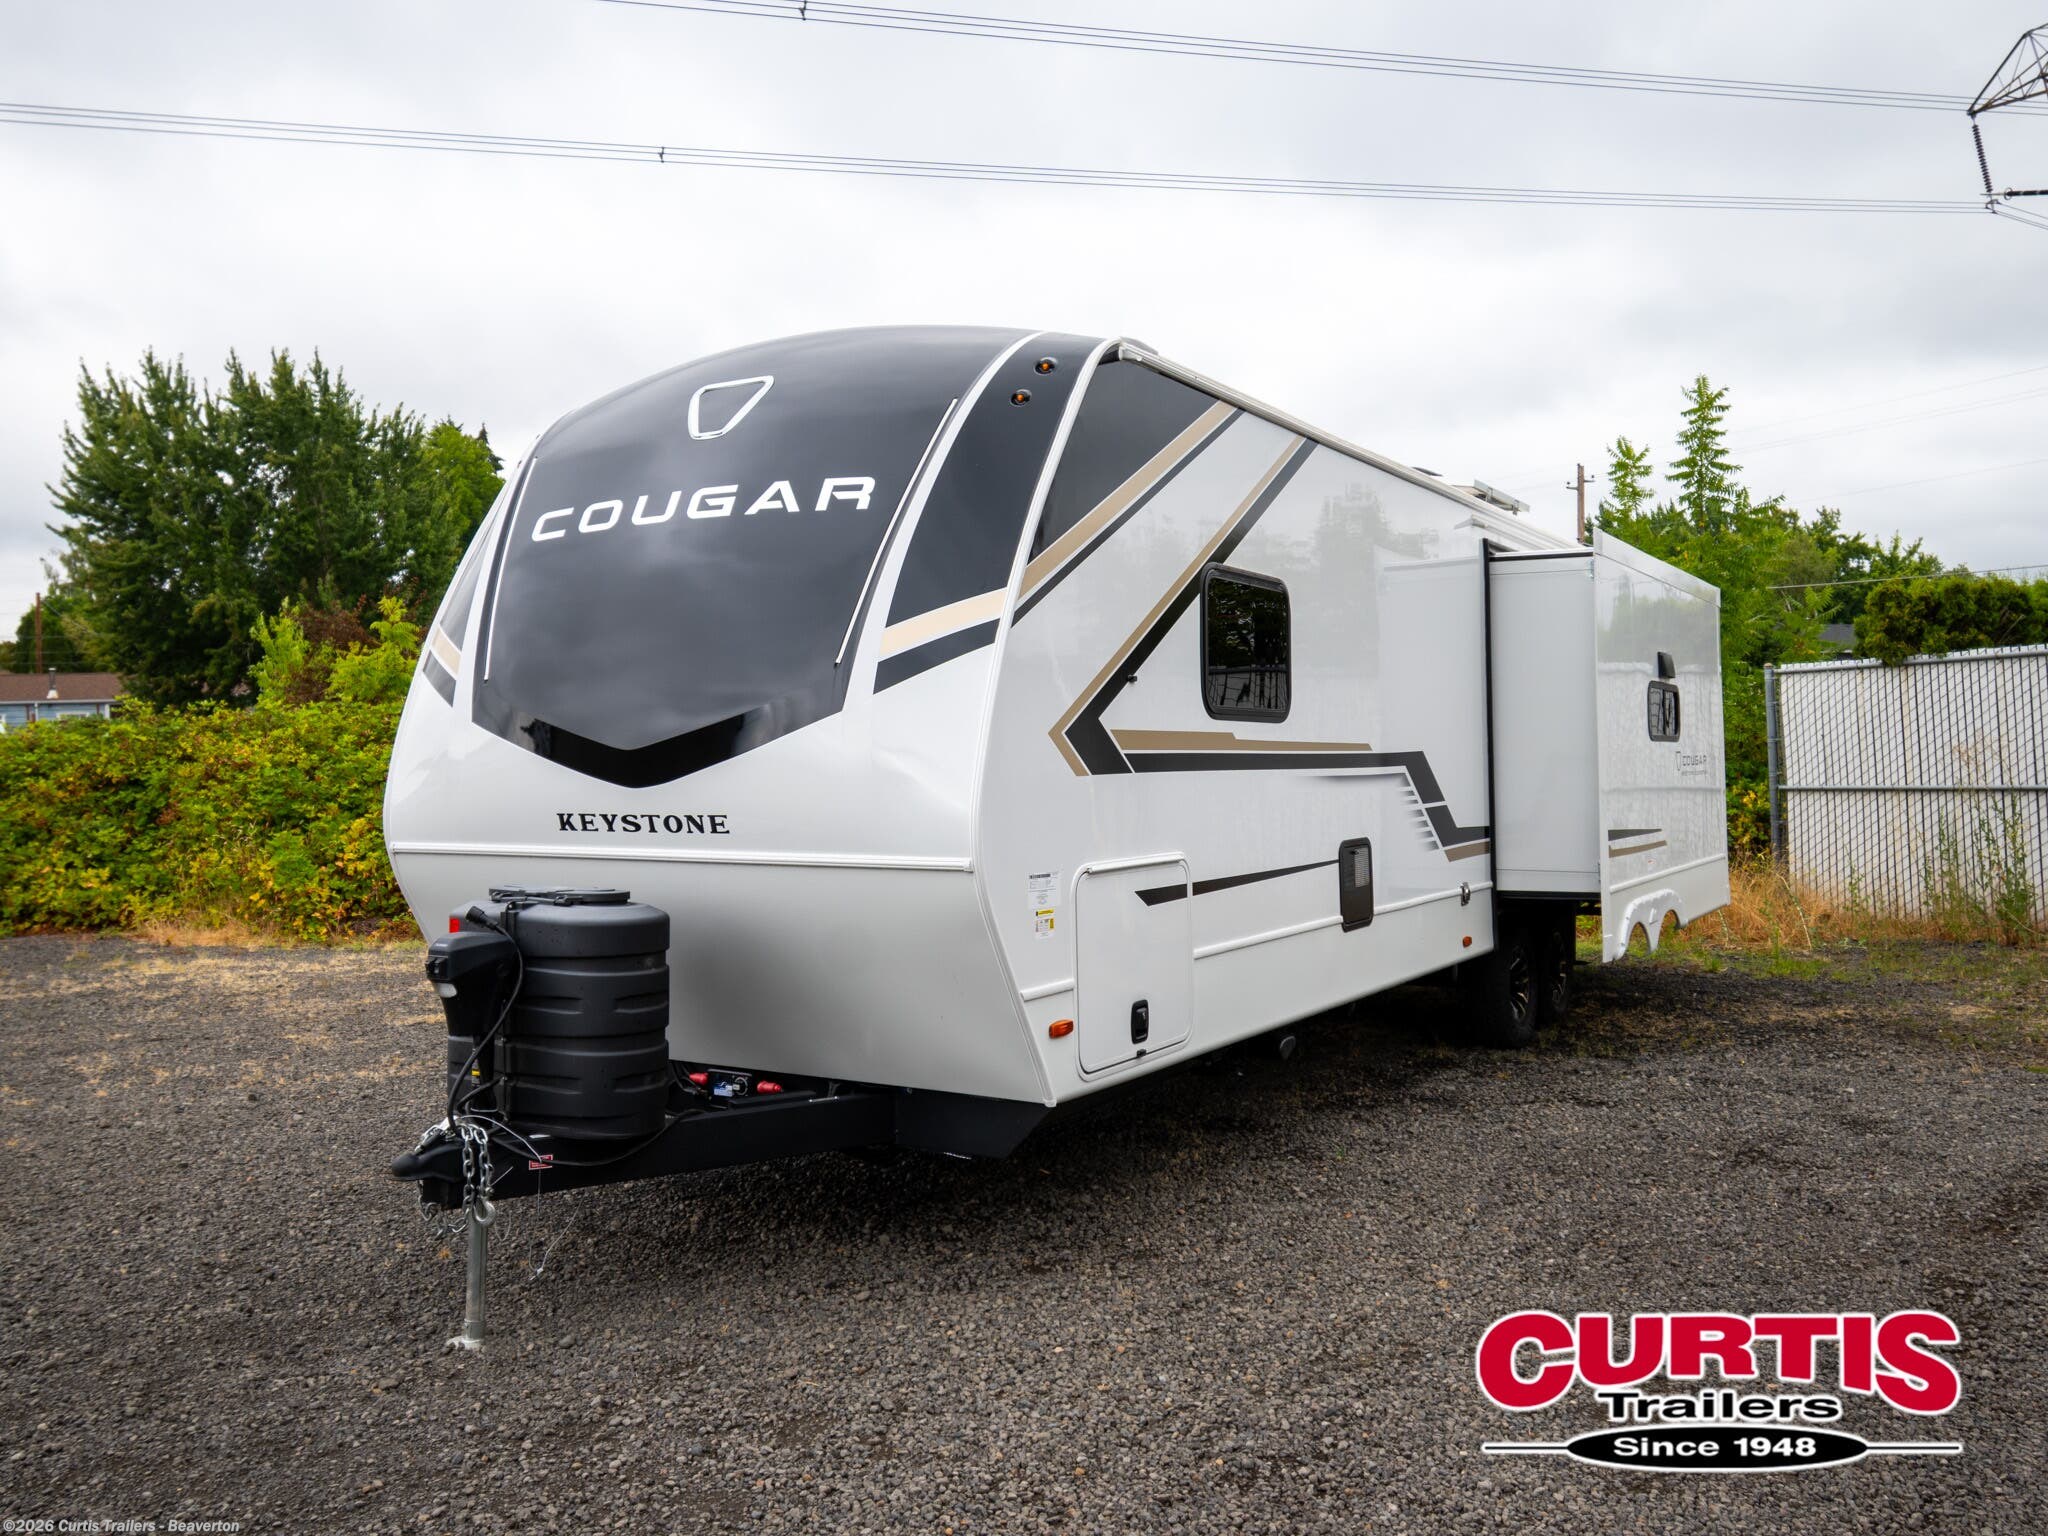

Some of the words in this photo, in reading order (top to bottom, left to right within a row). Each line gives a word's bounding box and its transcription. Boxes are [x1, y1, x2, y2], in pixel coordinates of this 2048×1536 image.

[531, 476, 875, 541] COUGAR
[1682, 754, 1707, 767] COUGAR
[556, 813, 730, 834] KEYSTONE
